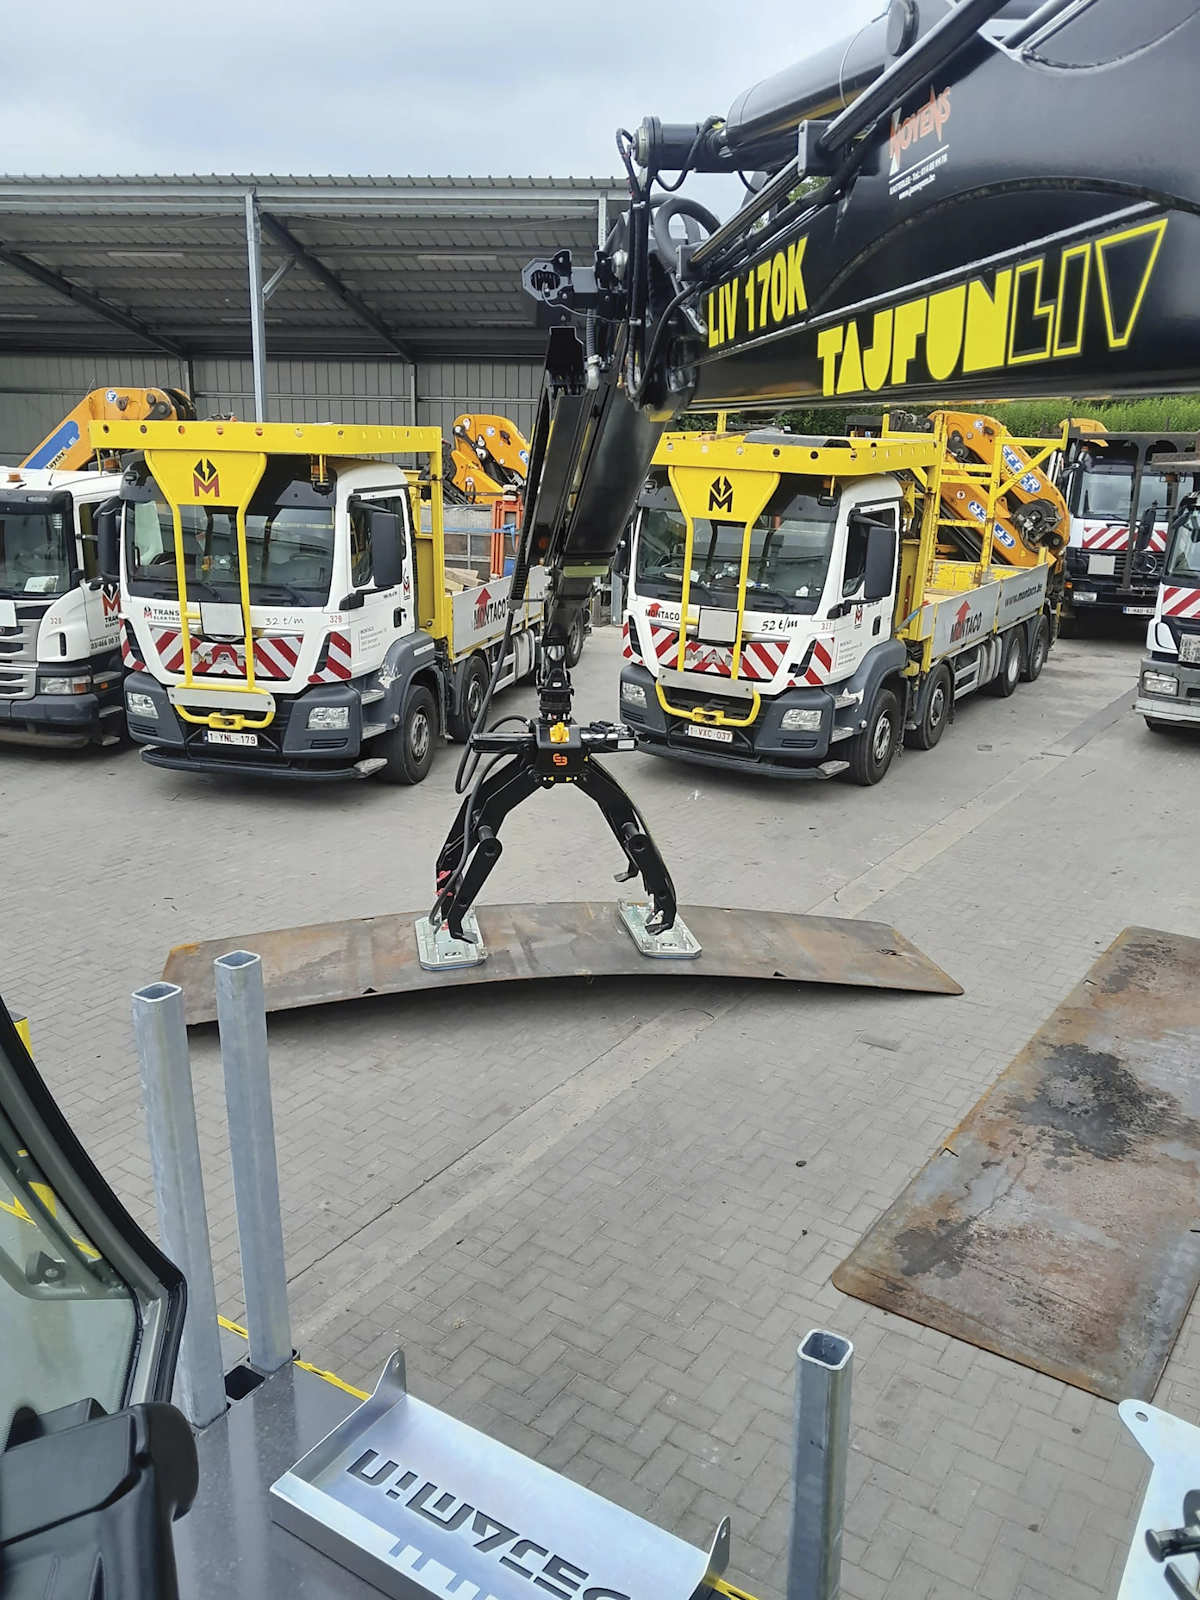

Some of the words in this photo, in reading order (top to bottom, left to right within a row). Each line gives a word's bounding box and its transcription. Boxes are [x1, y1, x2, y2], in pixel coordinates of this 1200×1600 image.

[708, 277, 739, 348] LIV
[745, 236, 808, 332] 170K
[817, 269, 1014, 397] TAJFUN
[153, 608, 179, 616] TRANS
[473, 598, 506, 630] MONTACO
[645, 608, 681, 621] MONTACO
[50, 617, 62, 625] 328
[265, 617, 279, 626] 32
[761, 620, 775, 632] 52
[821, 622, 832, 631] 327
[950, 611, 982, 644] MONTACO
[209, 732, 256, 745] 1-YNL-179
